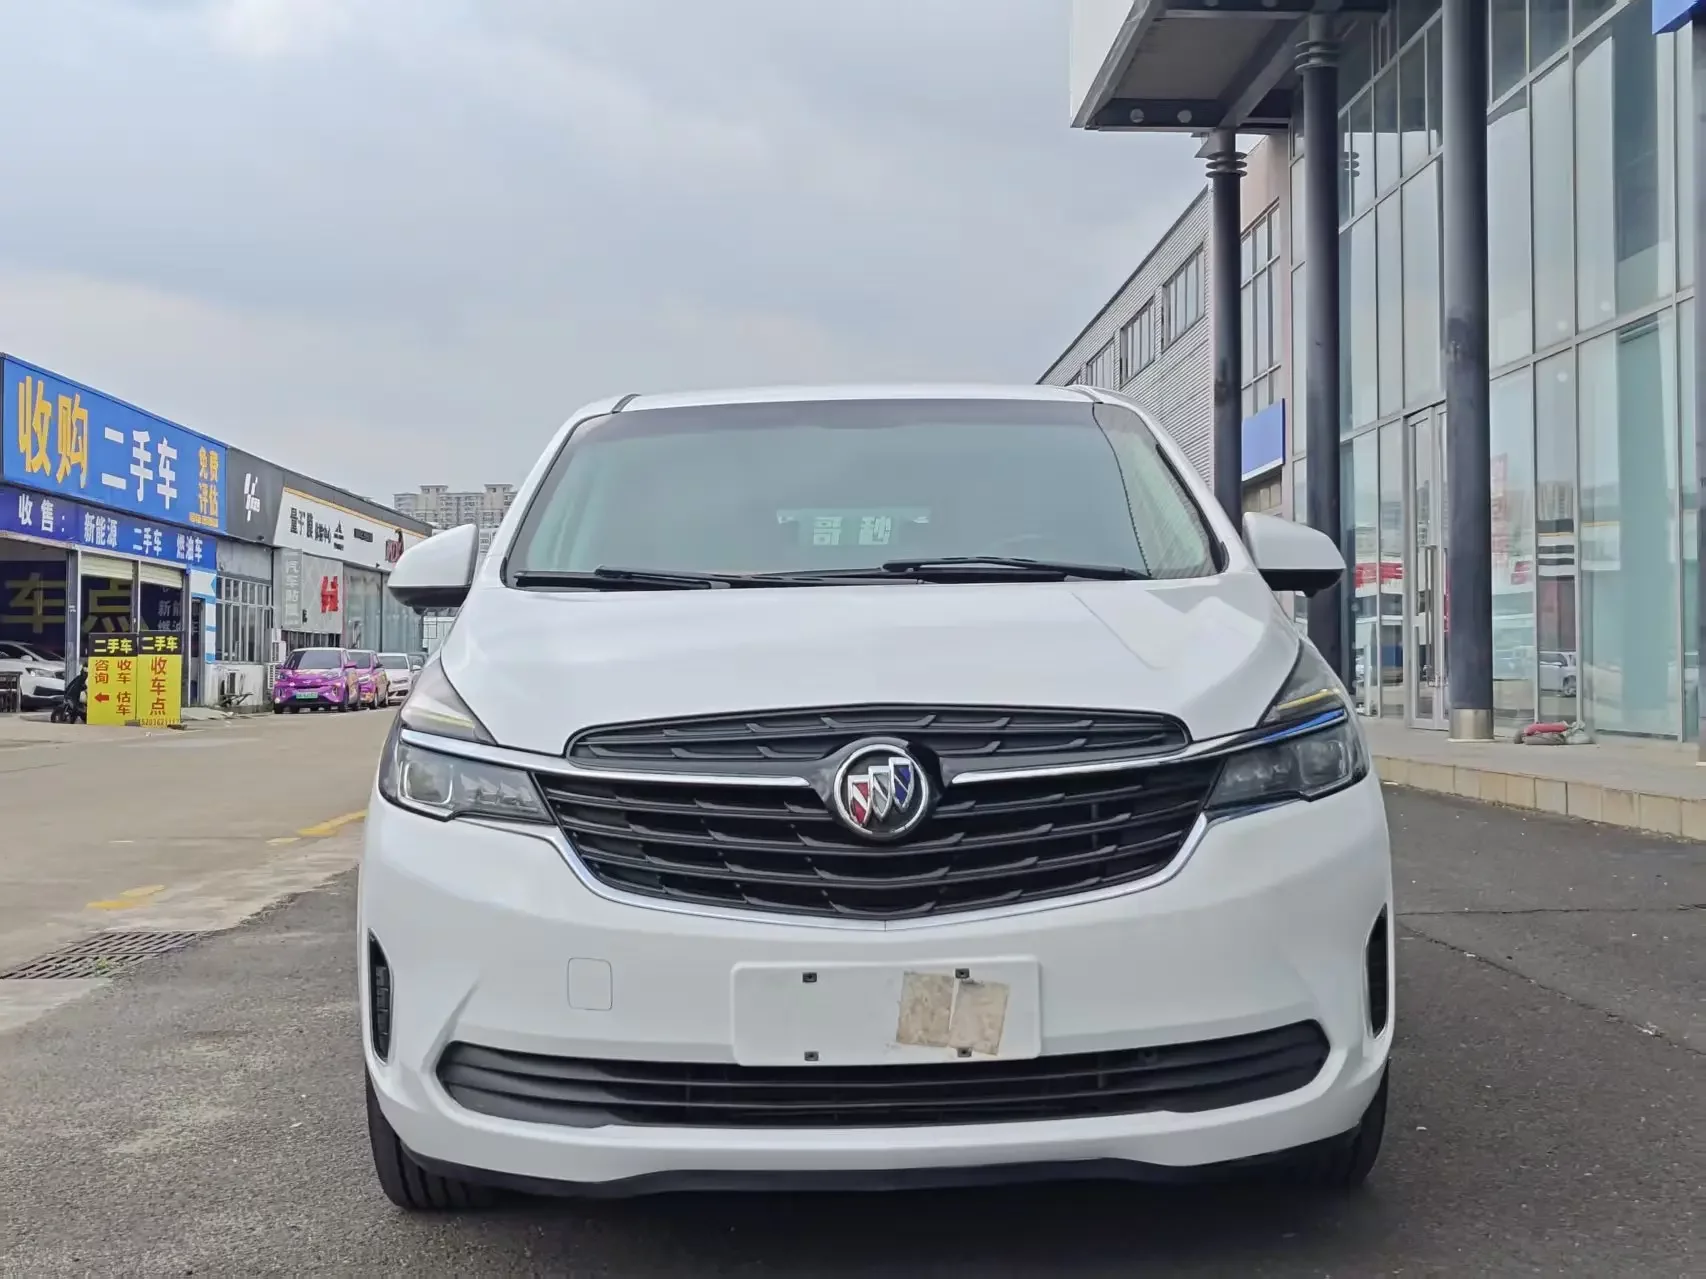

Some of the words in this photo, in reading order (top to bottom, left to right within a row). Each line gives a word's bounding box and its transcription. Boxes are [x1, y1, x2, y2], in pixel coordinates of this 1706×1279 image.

[18, 375, 89, 489] 收购
[101, 425, 178, 511] 二手车
[83, 511, 119, 549] 新能源
[132, 527, 163, 555] 二手车
[94, 638, 133, 654] 二手车
[142, 635, 178, 652] 二手车
[94, 659, 110, 685] 咨询
[149, 656, 168, 716] 收车点
